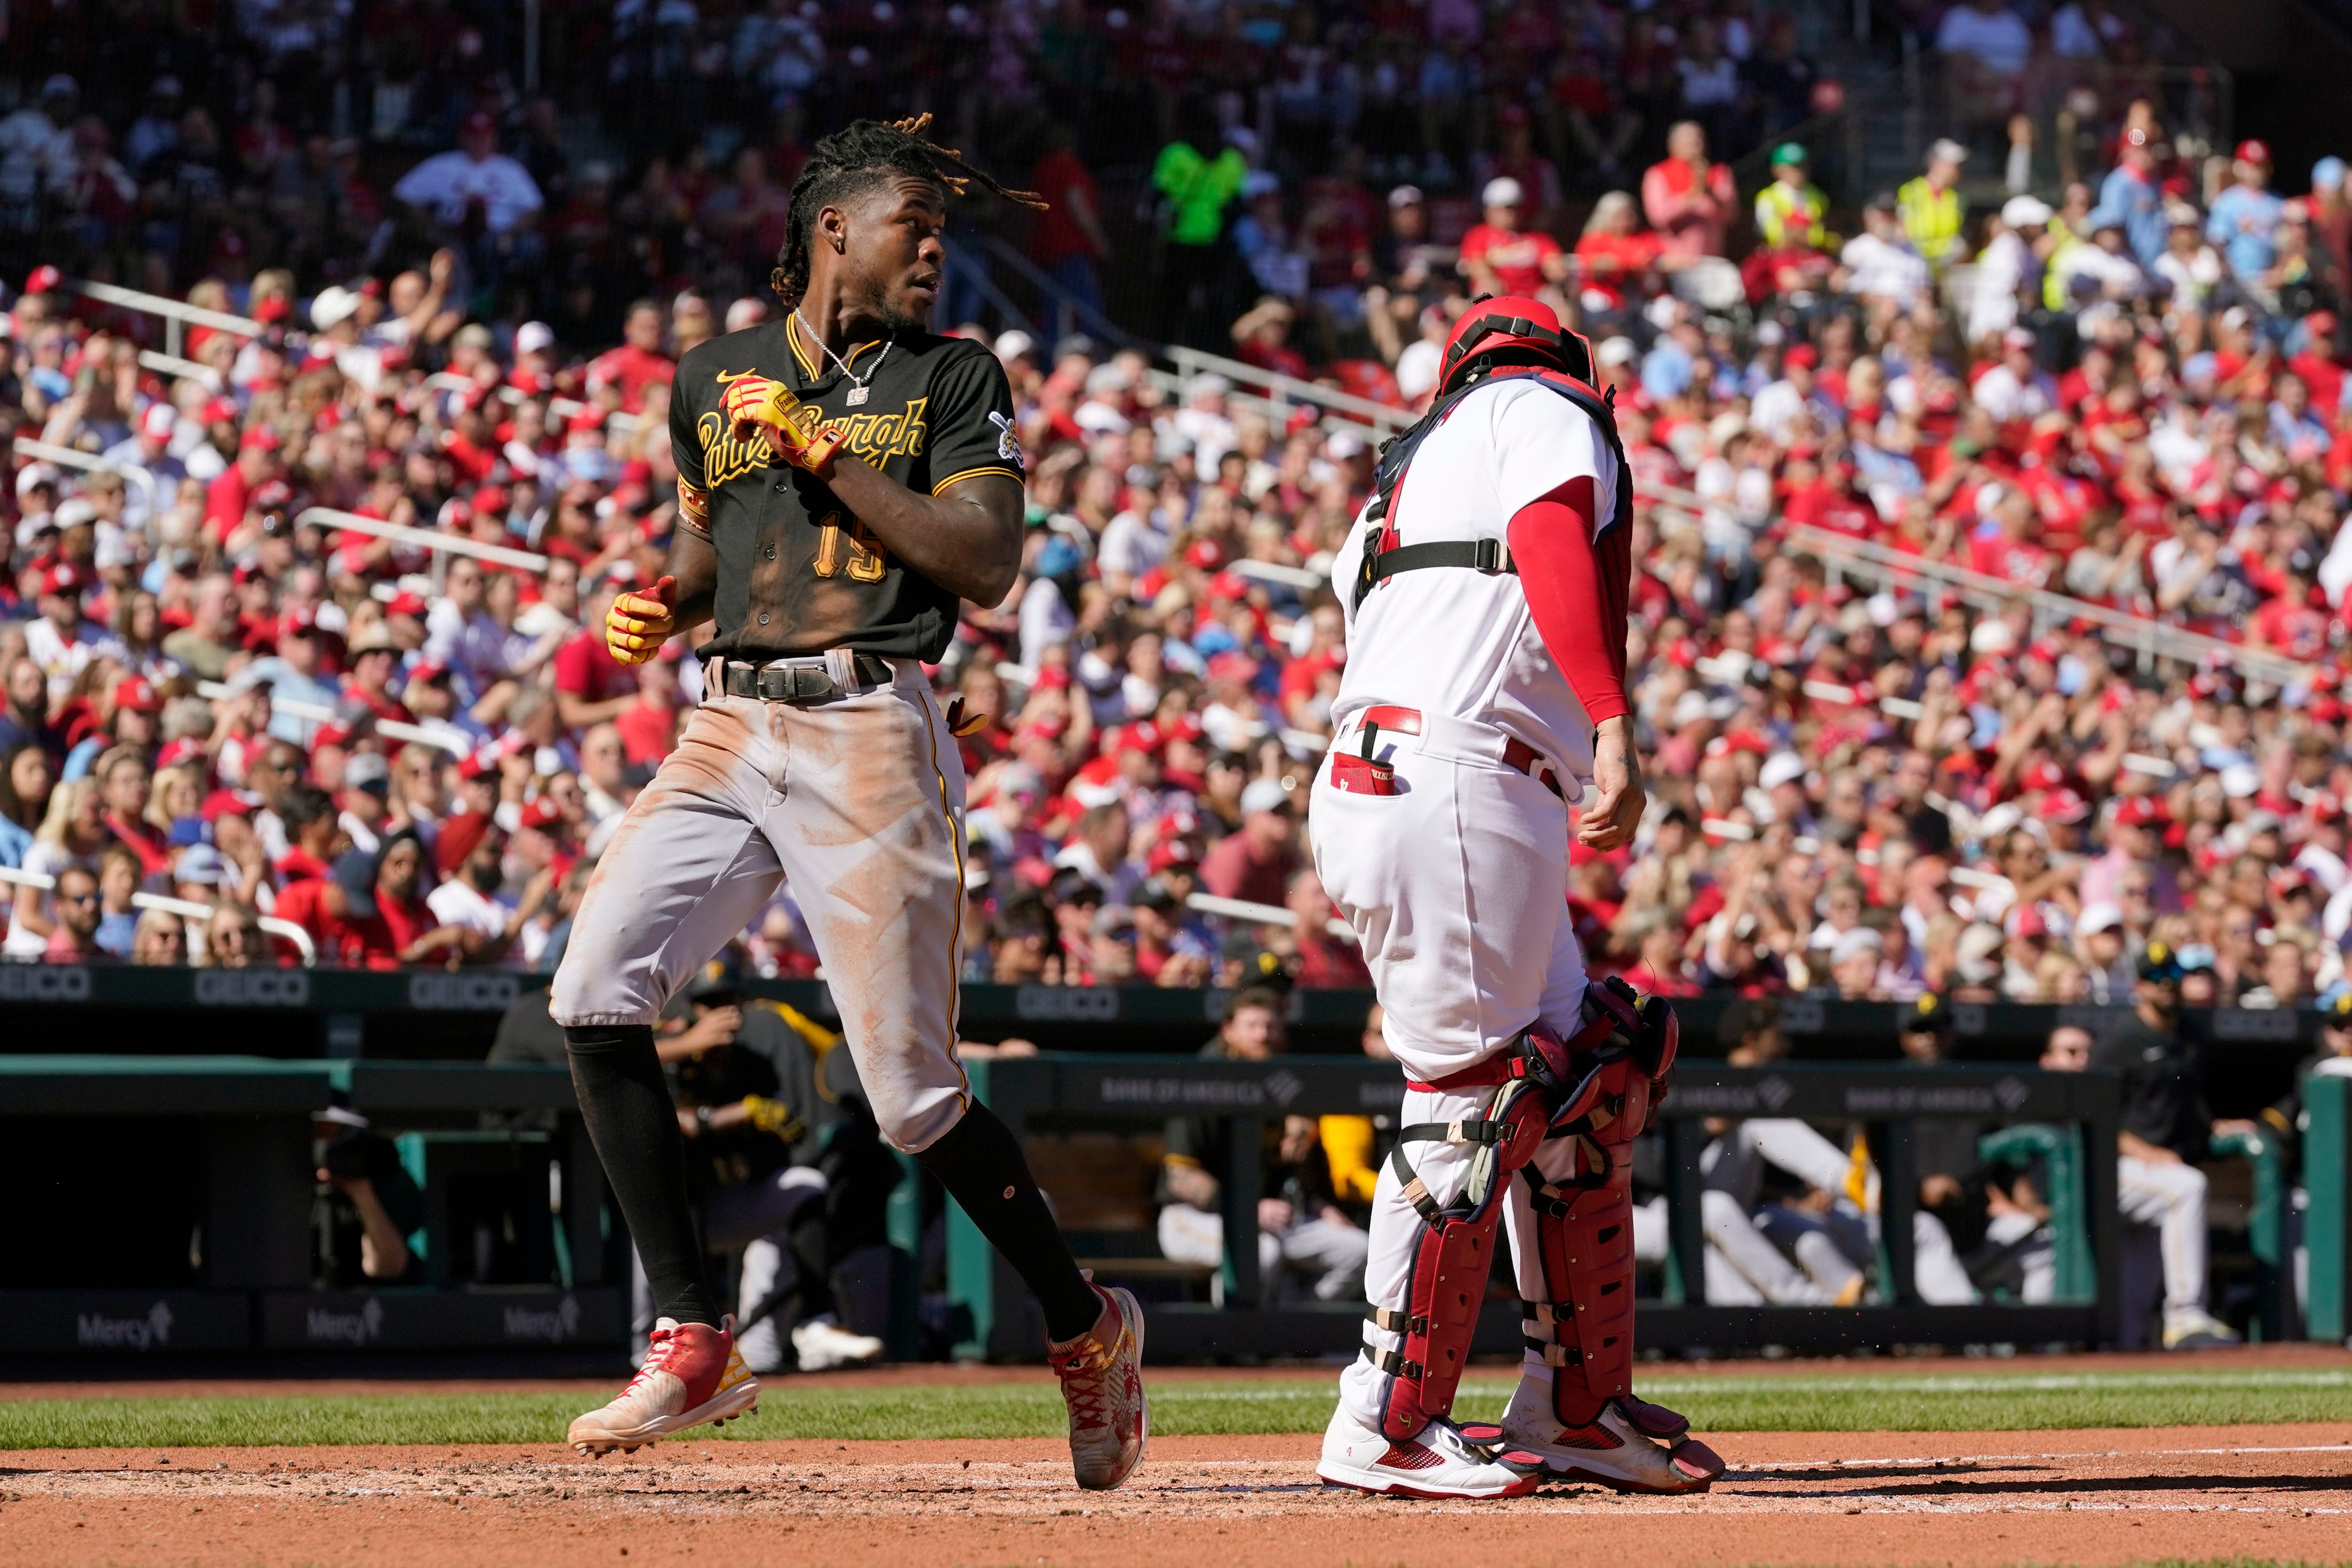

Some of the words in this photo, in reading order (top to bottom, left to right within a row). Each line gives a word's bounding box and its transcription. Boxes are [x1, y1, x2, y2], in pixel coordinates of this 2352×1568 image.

[813, 511, 888, 584] 15
[0, 966, 90, 1000] EICO
[194, 970, 308, 1005] GEICO
[408, 974, 520, 1010] GEICO
[1017, 986, 1119, 1020] GEICO
[77, 1314, 153, 1351] Mercy
[307, 1307, 366, 1346] Mercy
[1347, 1446, 1352, 1457] 4
